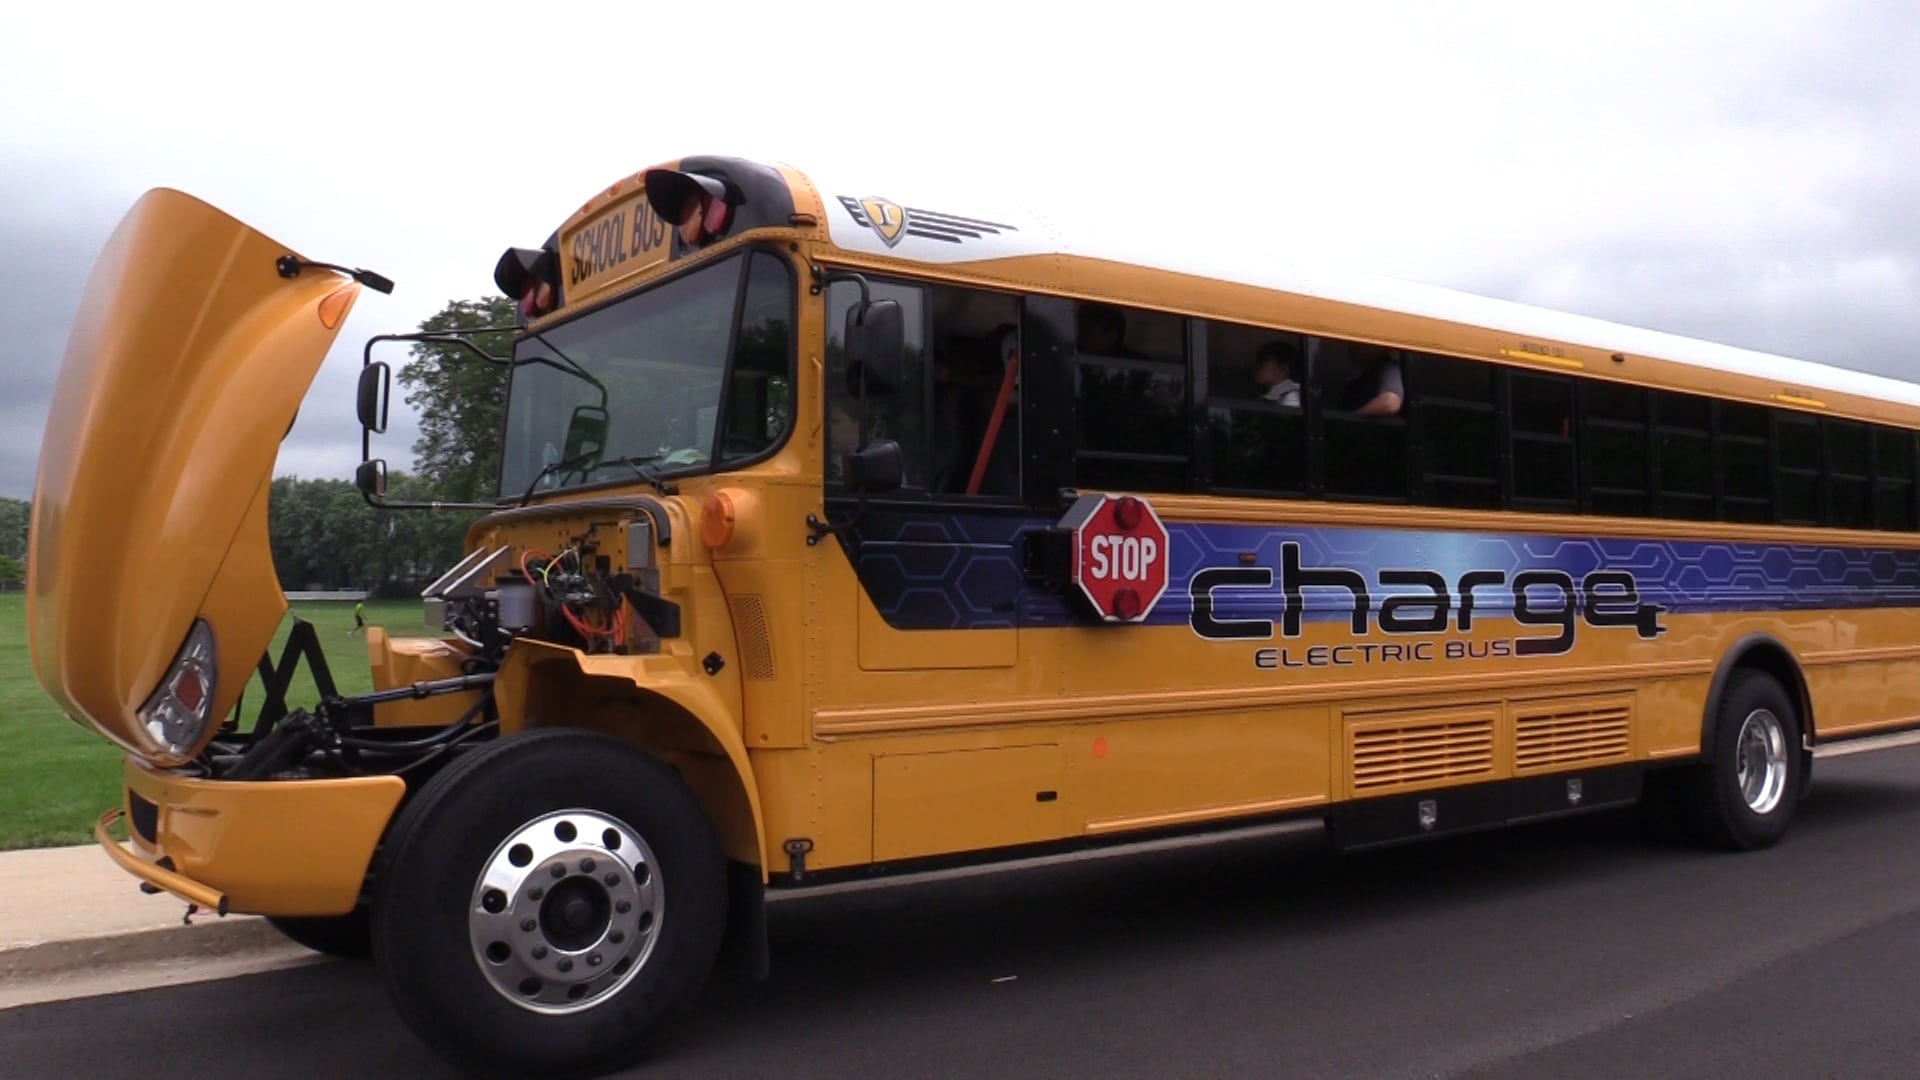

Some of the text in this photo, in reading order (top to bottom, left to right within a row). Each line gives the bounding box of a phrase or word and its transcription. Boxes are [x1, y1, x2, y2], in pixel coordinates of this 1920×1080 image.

[572, 197, 666, 286] SCHOOL BUS
[1090, 533, 1157, 582] STOP
[1189, 541, 1650, 656] charge
[1255, 638, 1512, 669] ELECTRIC BUS
